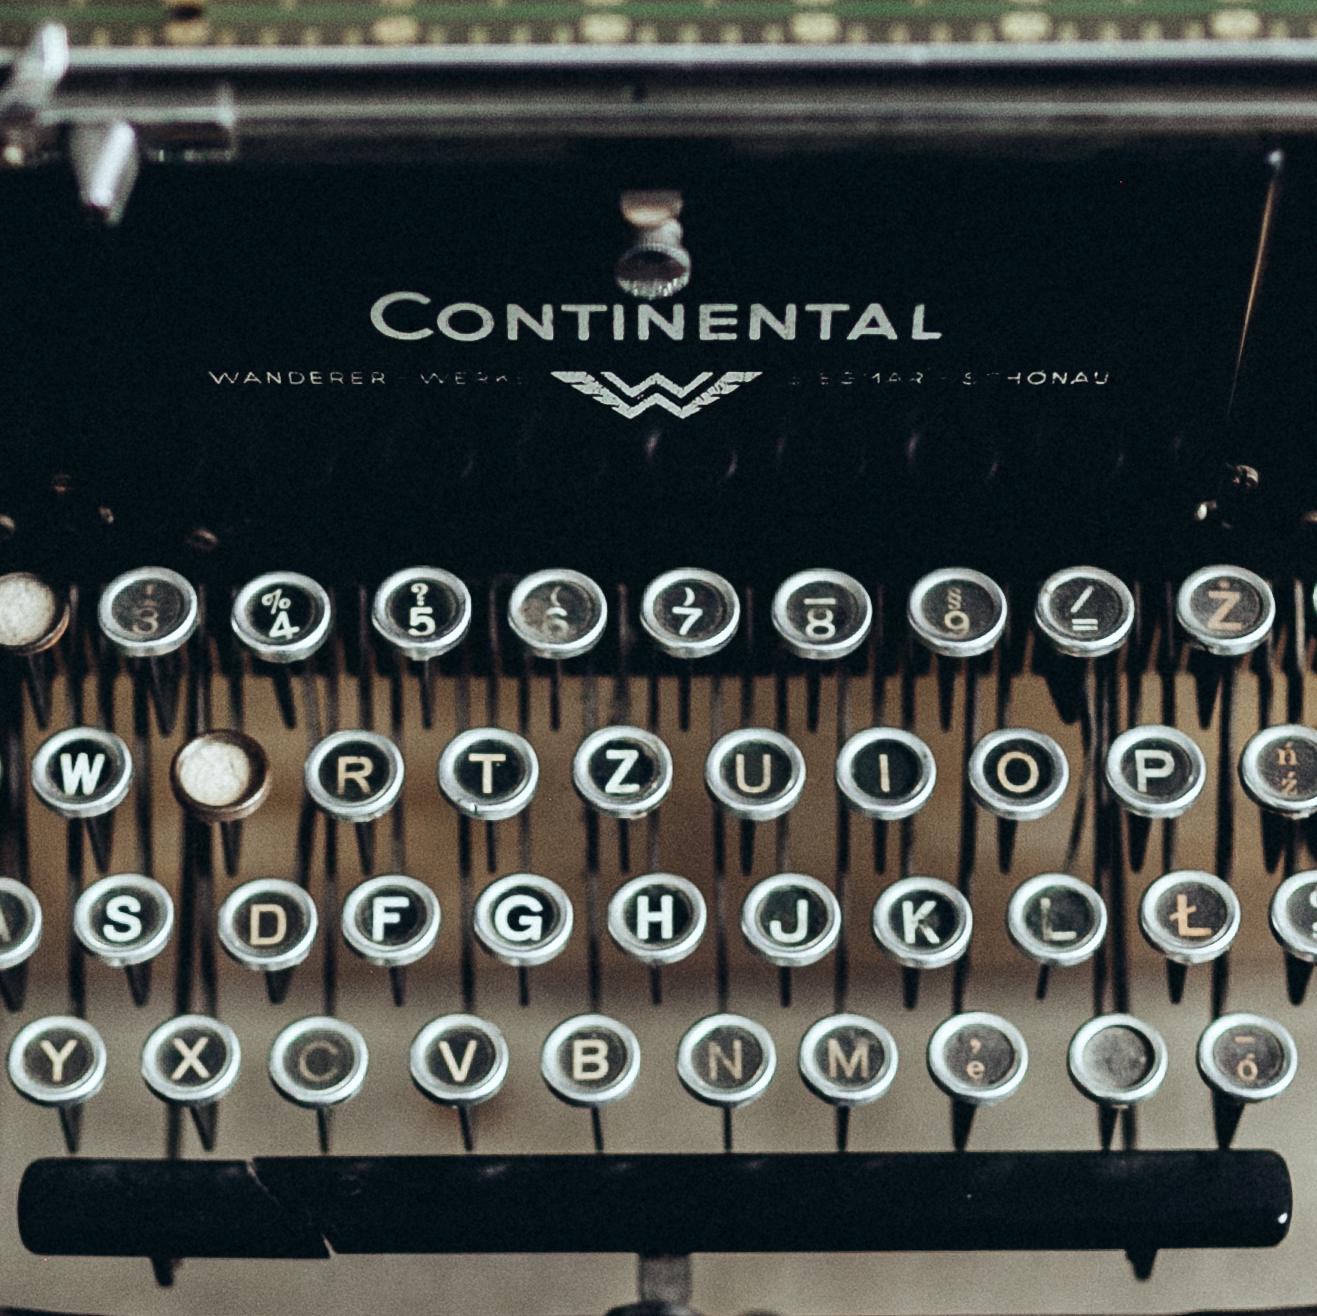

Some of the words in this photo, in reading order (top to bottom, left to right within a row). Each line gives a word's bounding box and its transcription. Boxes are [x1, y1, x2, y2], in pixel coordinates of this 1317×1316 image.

[208, 371, 385, 385] WANDERER
[262, 589, 291, 615] %
[411, 583, 429, 606] ?
[269, 611, 300, 639] 4
[408, 607, 436, 636] 5
[672, 606, 703, 635] 7
[805, 608, 836, 639] 8
[944, 611, 970, 636] 9
[60, 753, 105, 795] W
[337, 756, 374, 795] R
[468, 753, 506, 794] T
[605, 749, 640, 794] Z
[735, 754, 771, 794] U
[879, 754, 890, 792] I
[997, 751, 1039, 794] O
[1135, 749, 1175, 792] P
[102, 895, 142, 942] S
[250, 904, 287, 945] D
[372, 896, 410, 942] F
[494, 894, 544, 942] G
[636, 895, 673, 940] H
[769, 899, 809, 943] J
[902, 900, 940, 944] K
[1040, 897, 1077, 942] L
[40, 1039, 78, 1082] Y
[171, 1037, 211, 1080] X
[299, 1040, 338, 1082] C
[438, 1040, 477, 1083] V
[572, 1039, 609, 1081] B
[708, 1039, 743, 1081] N
[827, 1037, 869, 1079] M
